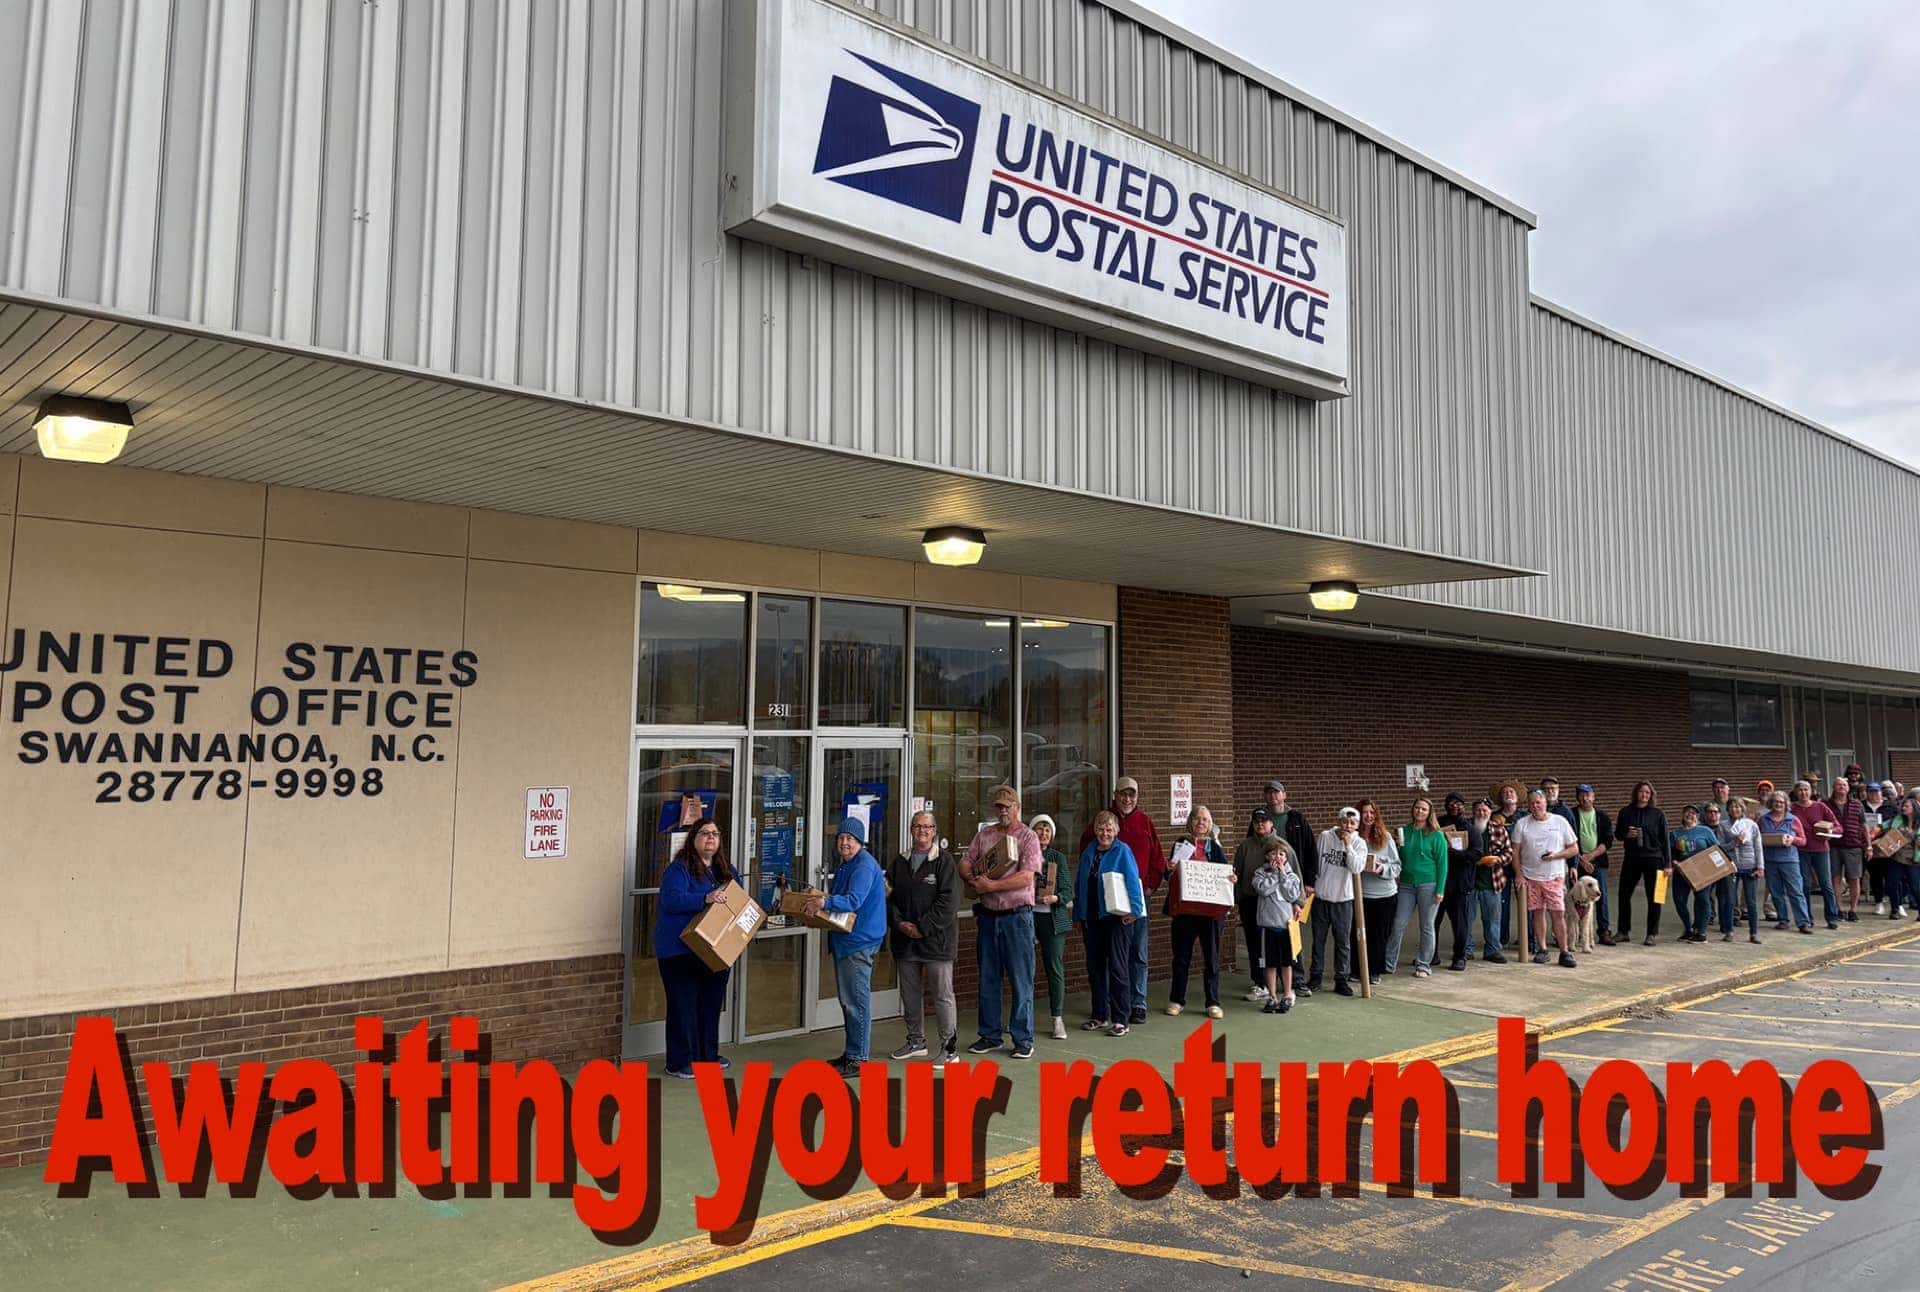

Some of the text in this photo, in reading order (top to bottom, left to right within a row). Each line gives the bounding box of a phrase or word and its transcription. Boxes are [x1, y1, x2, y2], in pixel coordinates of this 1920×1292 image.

[994, 113, 1319, 283] UNITED STATES
[981, 180, 1330, 346] POSTAL SERVICE
[282, 642, 478, 688] STATES
[12, 681, 453, 728] POST OFFICE
[18, 730, 445, 769] SWANNANOA, N.C.
[95, 767, 384, 803] 28778-9998
[539, 792, 555, 808] NO
[763, 801, 793, 809] WELCOME
[1175, 800, 1188, 809] FIRE
[530, 809, 563, 821] PARKING
[533, 824, 558, 836] FIRE
[530, 839, 561, 852] LANE
